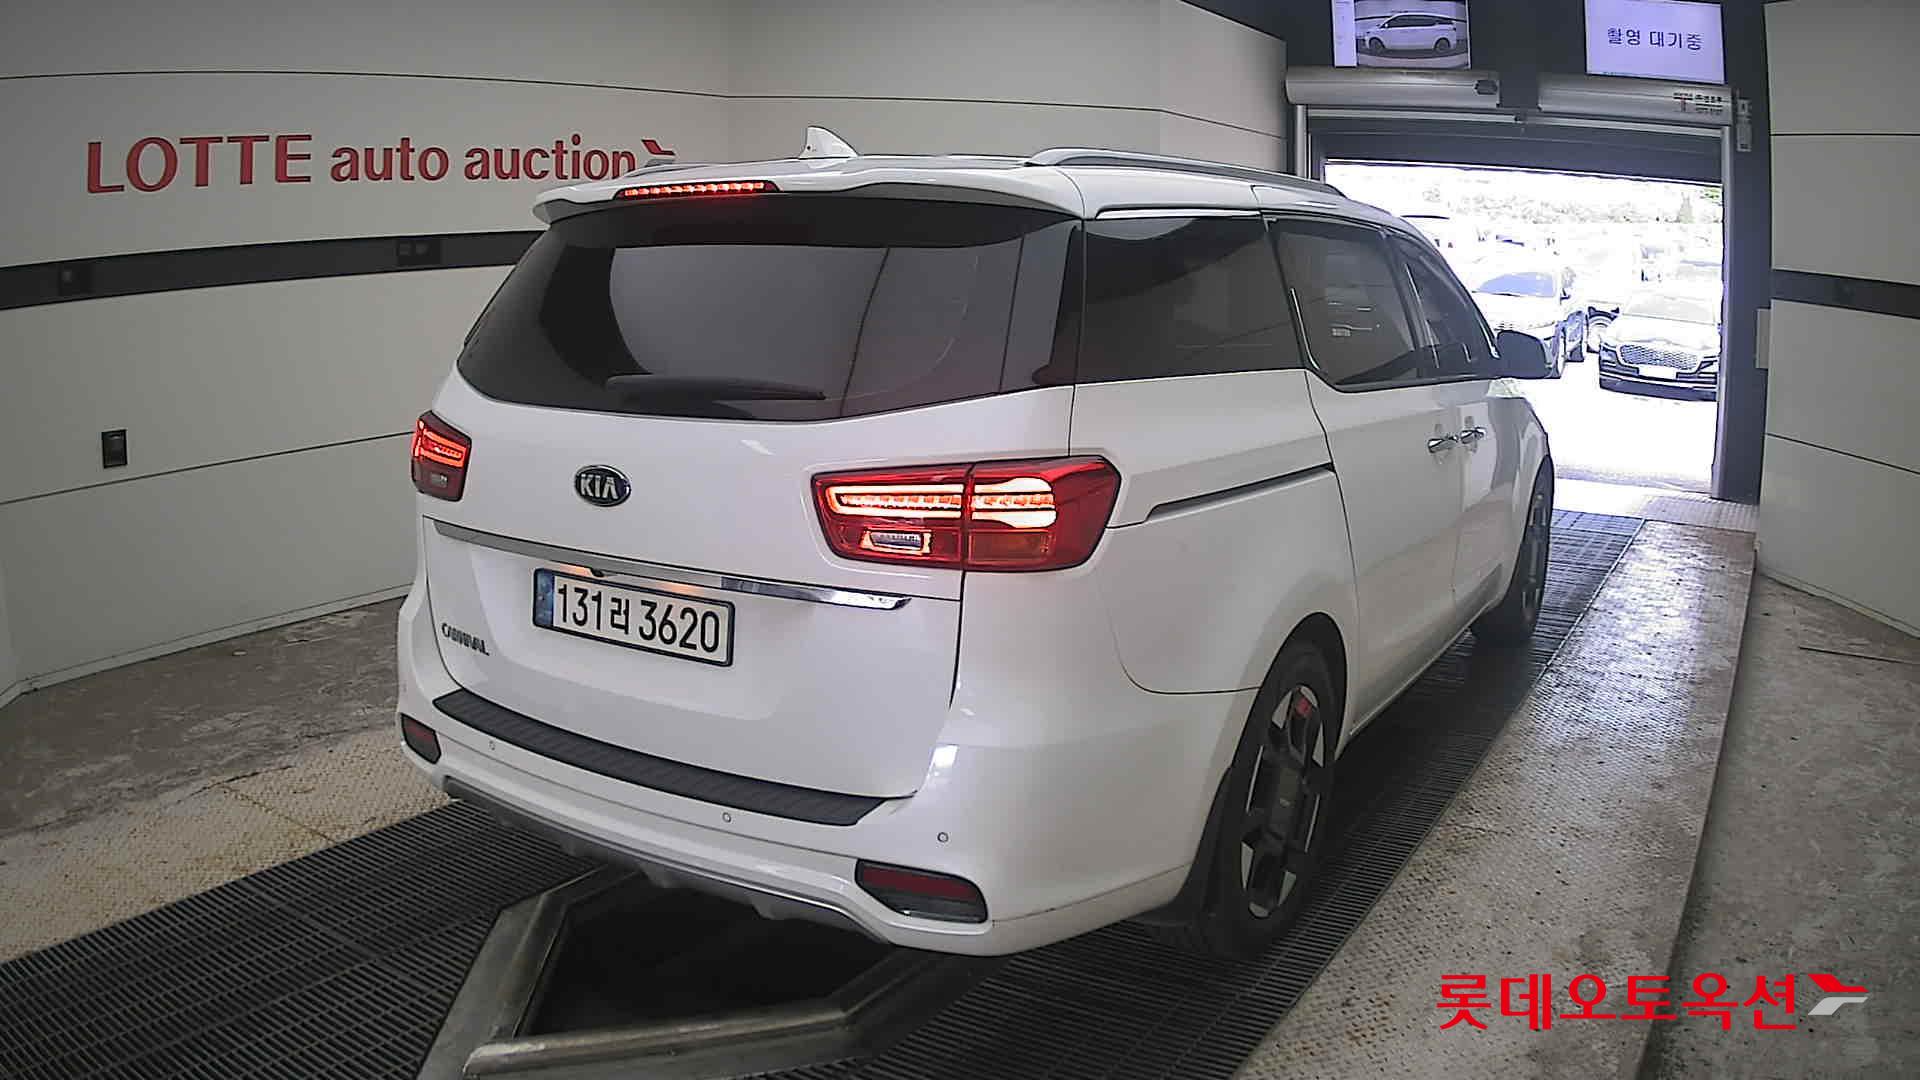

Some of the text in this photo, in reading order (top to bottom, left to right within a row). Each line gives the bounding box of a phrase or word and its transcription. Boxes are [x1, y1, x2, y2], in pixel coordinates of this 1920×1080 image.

[87, 133, 636, 194] LOTTE auto auction
[580, 473, 619, 500] KIA
[441, 622, 490, 656] CAVAL
